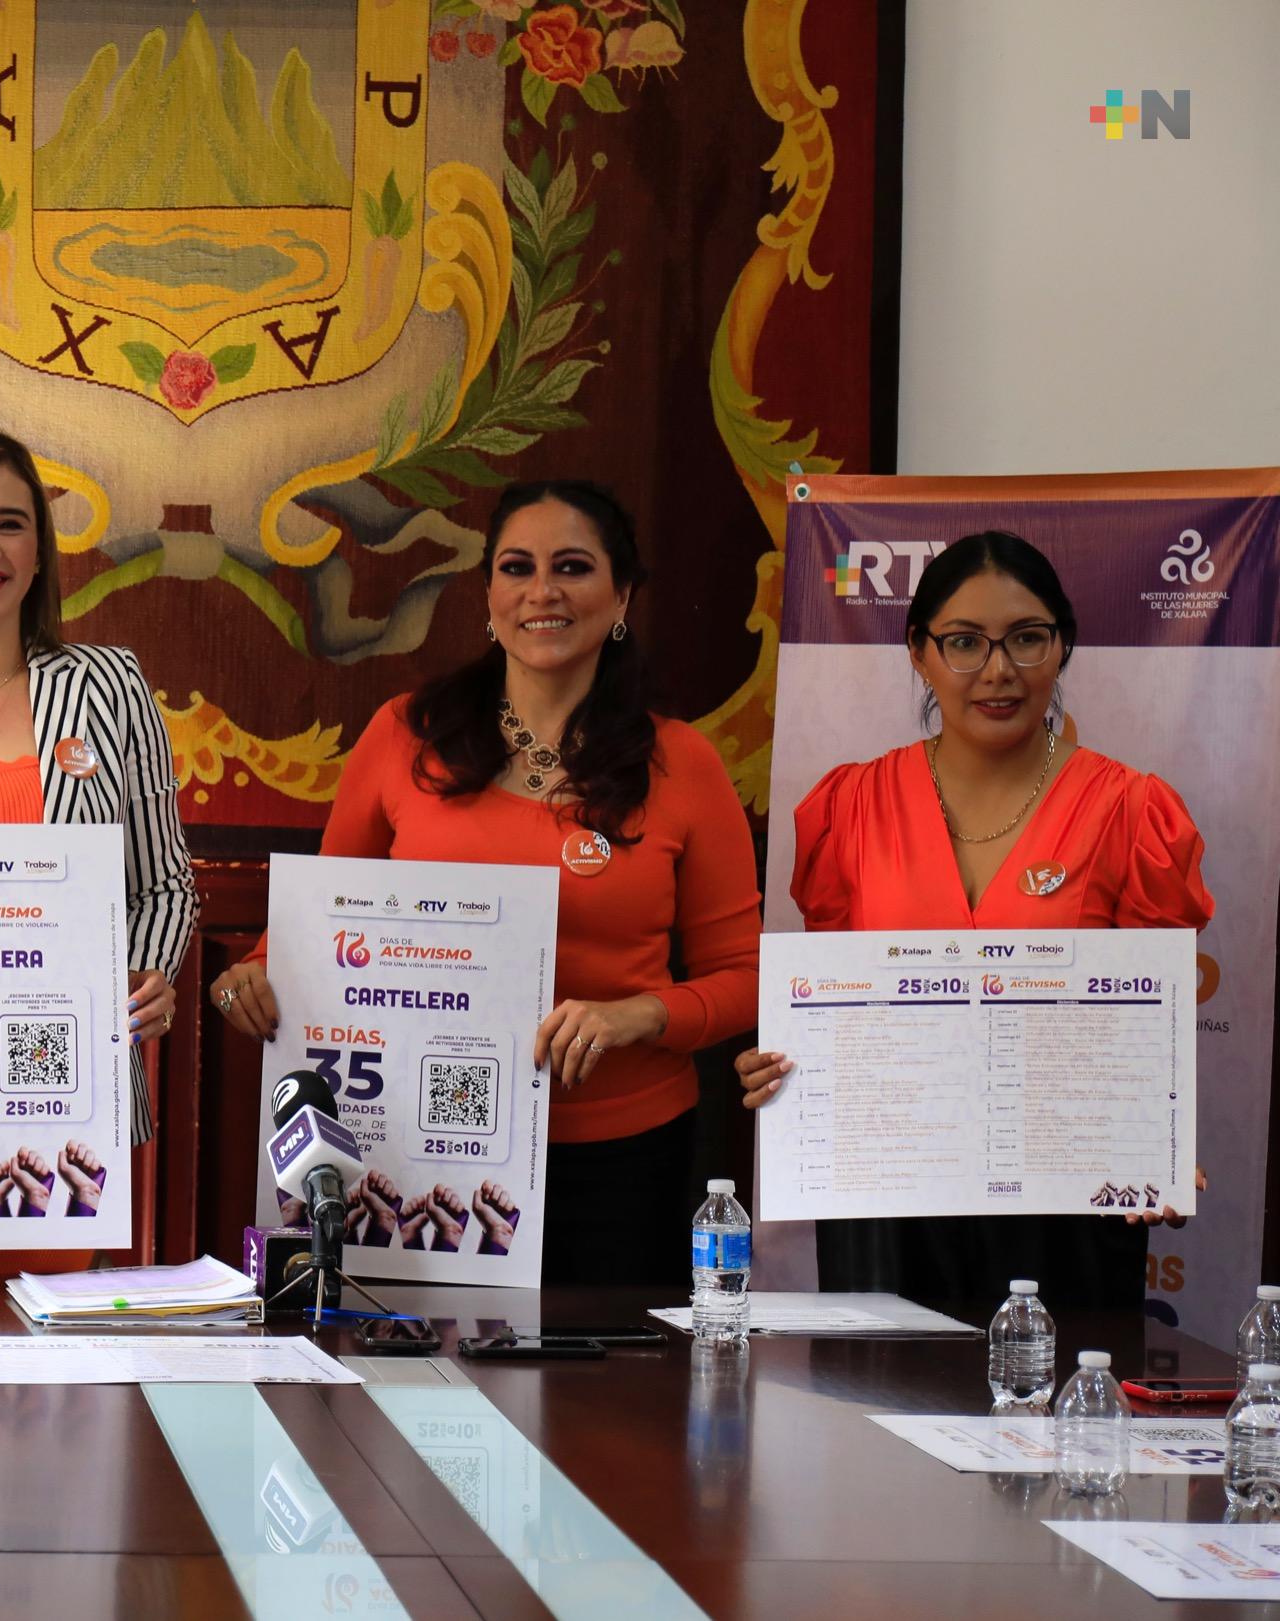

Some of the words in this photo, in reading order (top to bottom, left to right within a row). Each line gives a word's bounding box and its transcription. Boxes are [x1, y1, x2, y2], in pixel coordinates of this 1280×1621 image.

[846, 541, 948, 596] RT
[875, 597, 913, 606] Televisión
[1140, 592, 1184, 601] INSTITUTO
[1186, 591, 1231, 600] MUNICIPAL
[1151, 601, 1162, 610] DE
[1164, 601, 1181, 609] LAS
[1182, 600, 1219, 609] MUJERES
[1161, 610, 1173, 619] DE
[1175, 610, 1207, 618] XALAPA
[579, 842, 594, 856] 16
[24, 860, 58, 871] Trabajo
[347, 898, 374, 908] Xalapa
[419, 901, 448, 913] RTV
[457, 902, 491, 912] Trabajo
[379, 936, 399, 945] DÍAS
[401, 938, 413, 946] DE
[380, 945, 472, 961] ACTIVISMO
[902, 948, 932, 957] Xalapa
[983, 945, 1015, 957] RTV
[1026, 944, 1064, 954] Trabajo
[818, 983, 873, 991] ACTIVISMO
[898, 978, 922, 994] 25
[941, 978, 961, 994] 10
[1010, 981, 1066, 989] ACTIVISMO
[1087, 978, 1112, 993] 25
[1133, 978, 1153, 993] 10
[344, 987, 470, 1011] CARTELERA
[304, 1025, 324, 1042] 16
[330, 1025, 387, 1049] DÍAS,
[306, 1048, 384, 1101] 35
[6, 1101, 28, 1116] 25
[45, 1100, 63, 1116] 10
[337, 1103, 386, 1115] IDADES
[339, 1119, 362, 1128] VOR
[372, 1120, 387, 1130] DE
[354, 1131, 386, 1142] CHOS
[279, 1127, 305, 1158] MN
[424, 1139, 446, 1154] 25
[463, 1140, 481, 1156] 10
